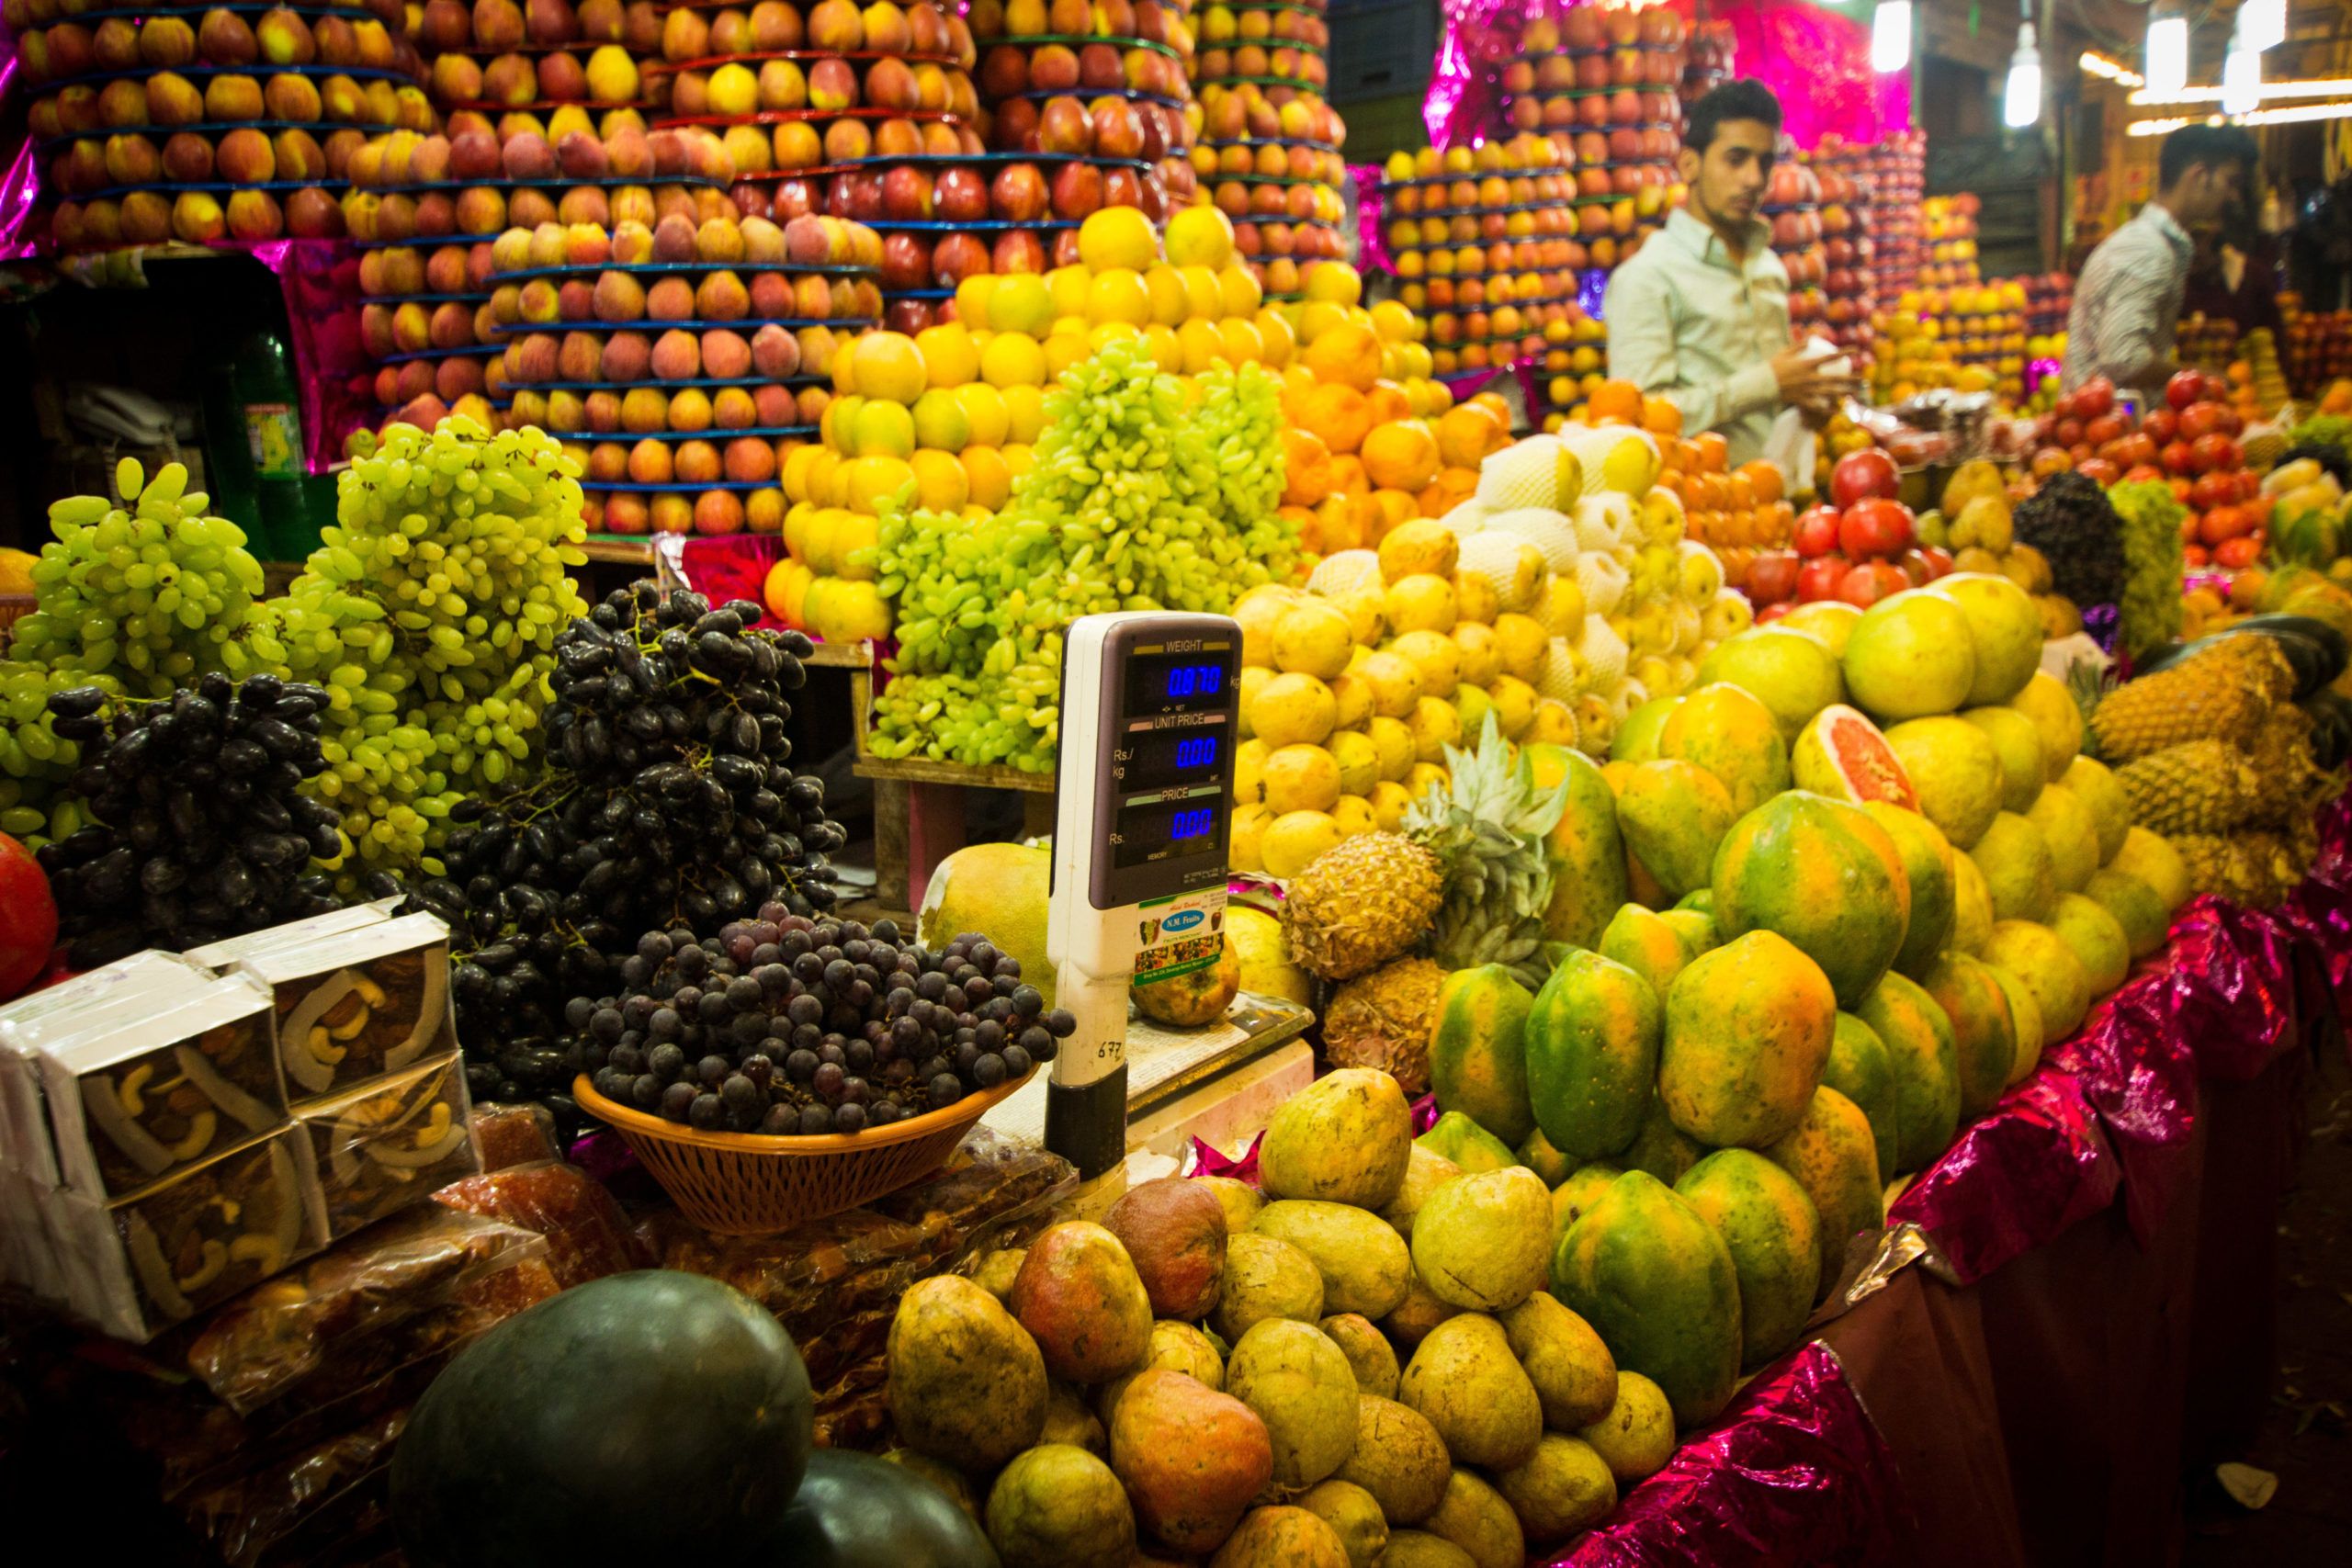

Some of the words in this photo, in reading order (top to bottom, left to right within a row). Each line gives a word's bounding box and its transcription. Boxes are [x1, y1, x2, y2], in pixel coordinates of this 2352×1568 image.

[1166, 640, 1202, 653] WEIGHT
[1230, 676, 1241, 689] kg
[1155, 716, 1176, 728] UNIT
[1177, 714, 1204, 727] PRICE
[1113, 766, 1125, 779] kg
[1161, 787, 1188, 801] PRICE
[1109, 833, 1125, 845] Rs.
[1148, 852, 1168, 861] MEMORY
[1182, 915, 1200, 925] Fruits
